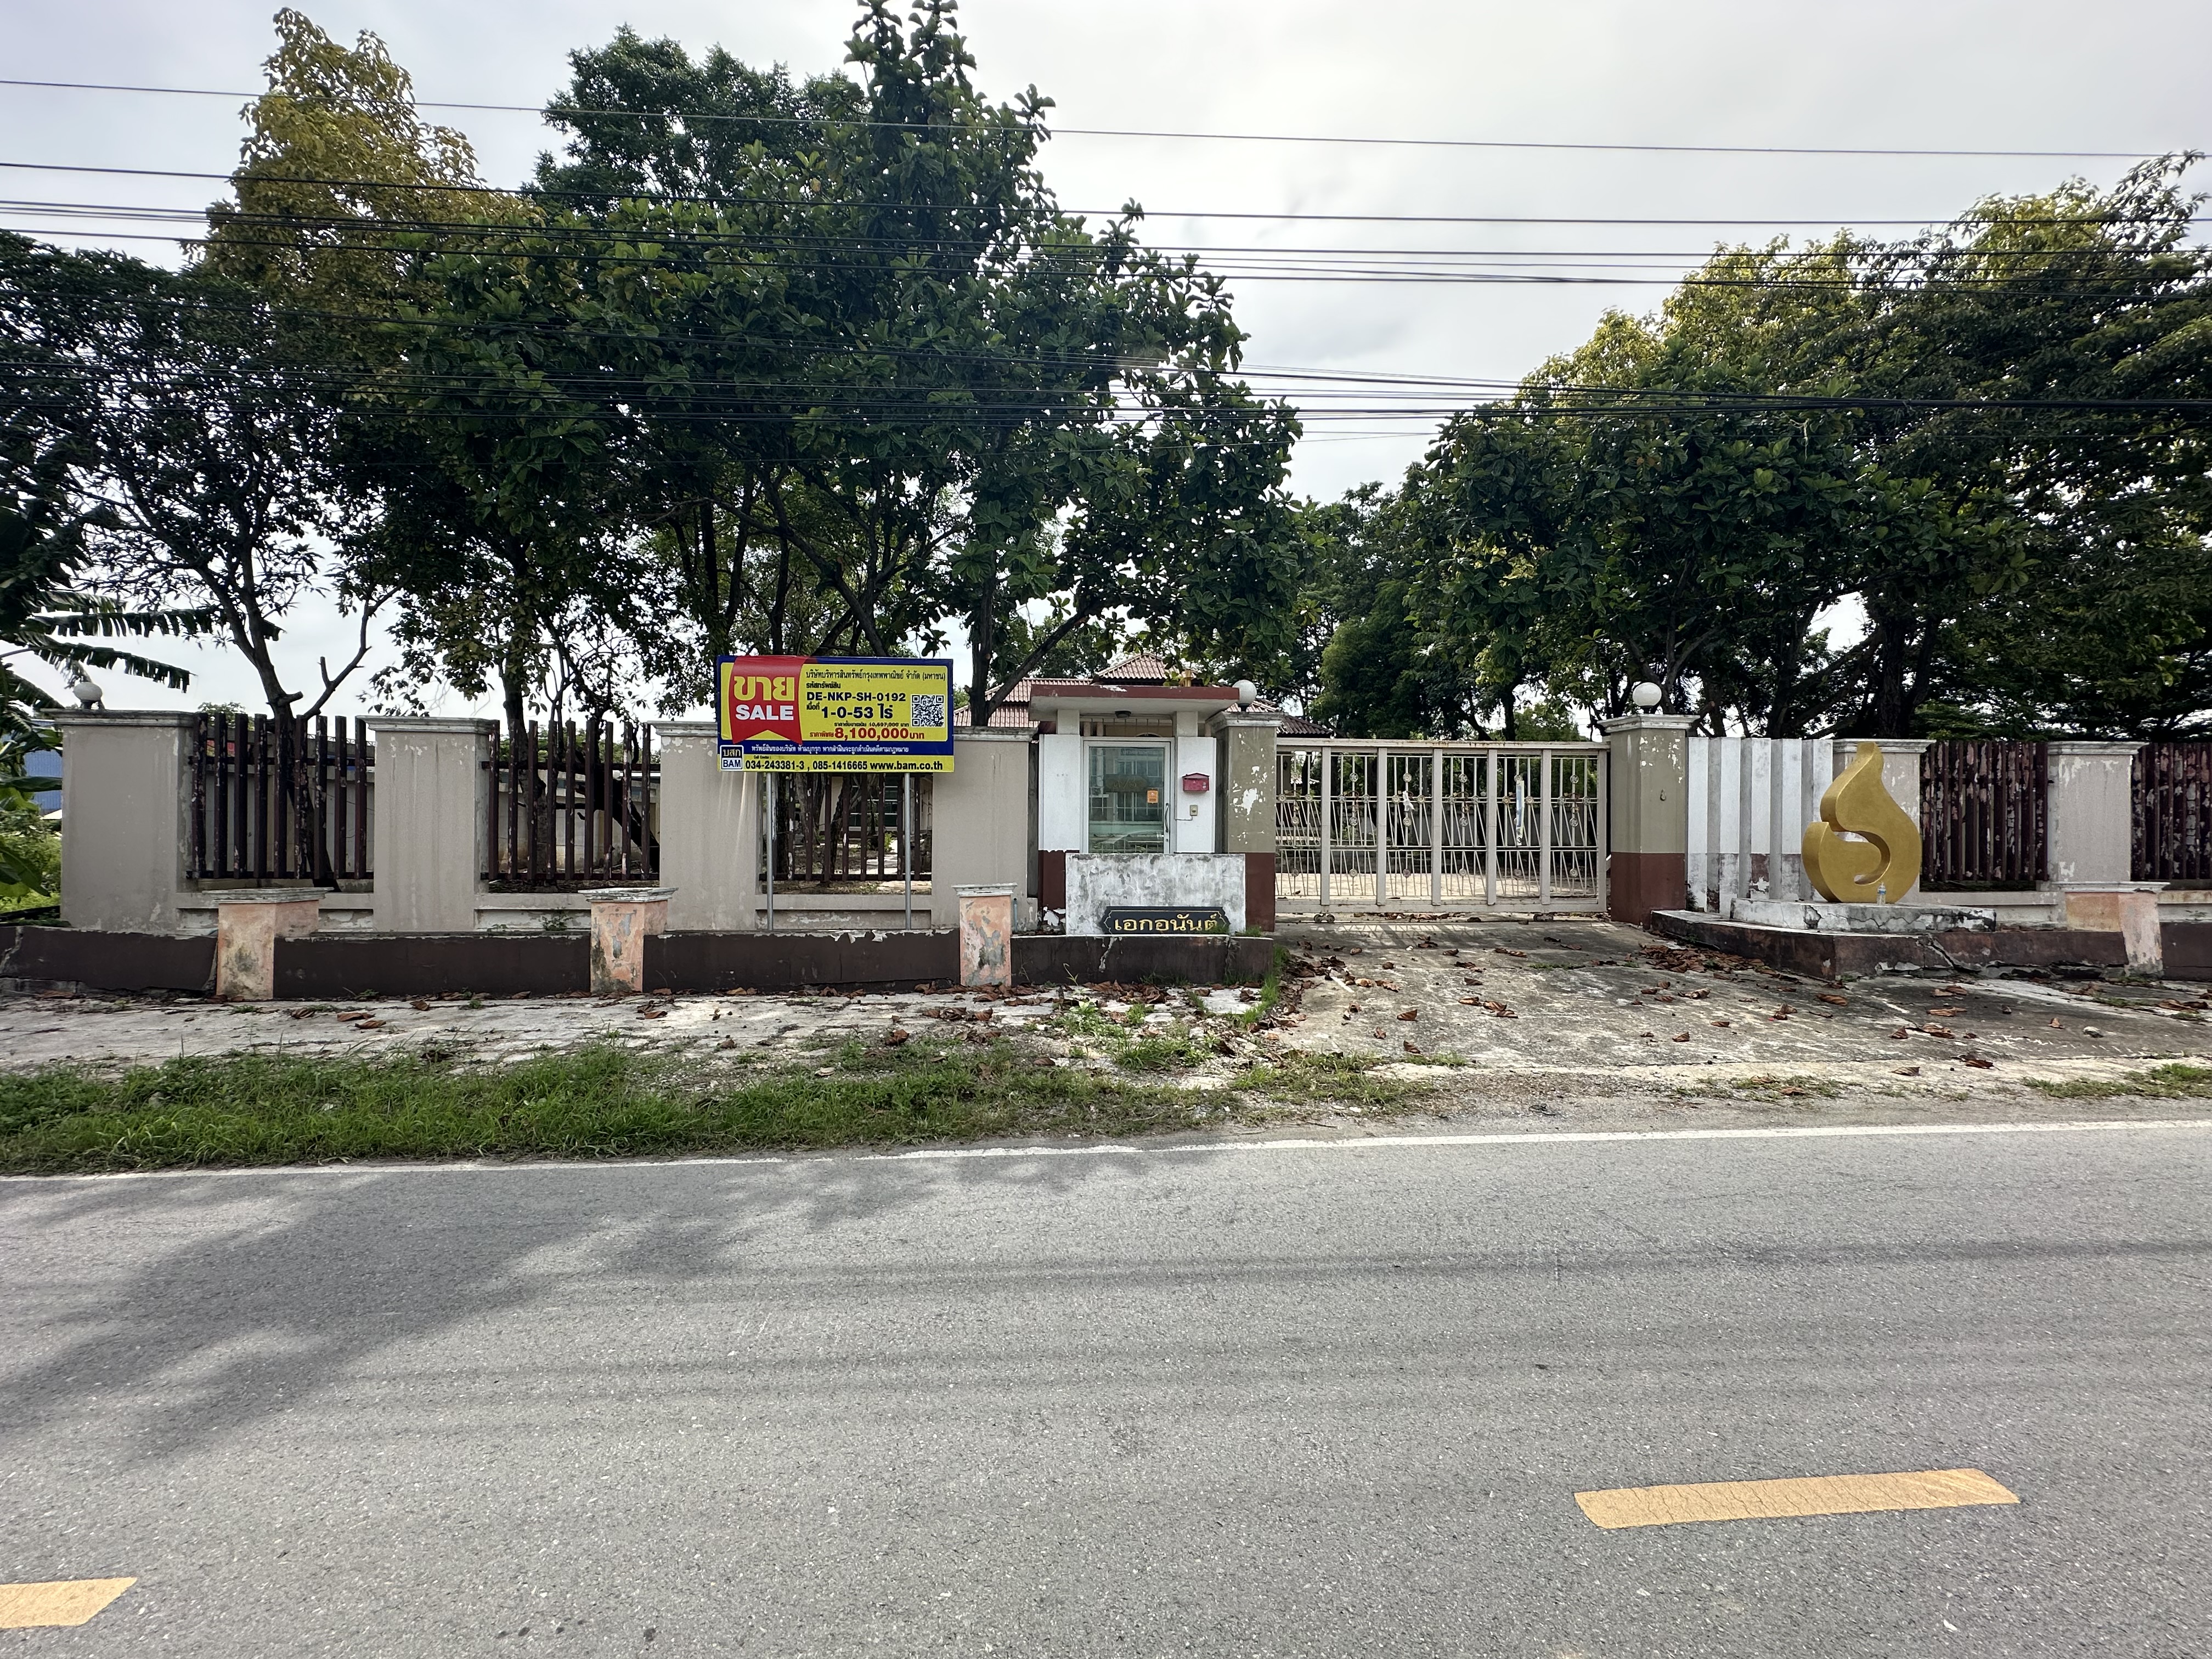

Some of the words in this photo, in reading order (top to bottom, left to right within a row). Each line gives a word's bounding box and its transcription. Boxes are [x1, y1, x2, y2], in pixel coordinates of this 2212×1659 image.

[906, 670, 920, 679] จำกัด
[923, 672, 946, 681] (มหาชน)
[733, 675, 795, 701] ขาย
[806, 692, 906, 702] DE-NKP-SH-0192
[806, 702, 820, 710] เนื้อที่
[821, 707, 873, 718] 1-0-53
[877, 703, 893, 719] ไร่
[736, 704, 794, 720] SALE
[834, 727, 909, 741] 8,100,000
[723, 748, 741, 757] บสก
[723, 759, 741, 768] BAM
[745, 760, 804, 770] 034-243381-3
[812, 761, 867, 770] 085-1416665
[870, 761, 943, 770] www.bam.co.th
[1114, 913, 1218, 931] เอกอนันต์
